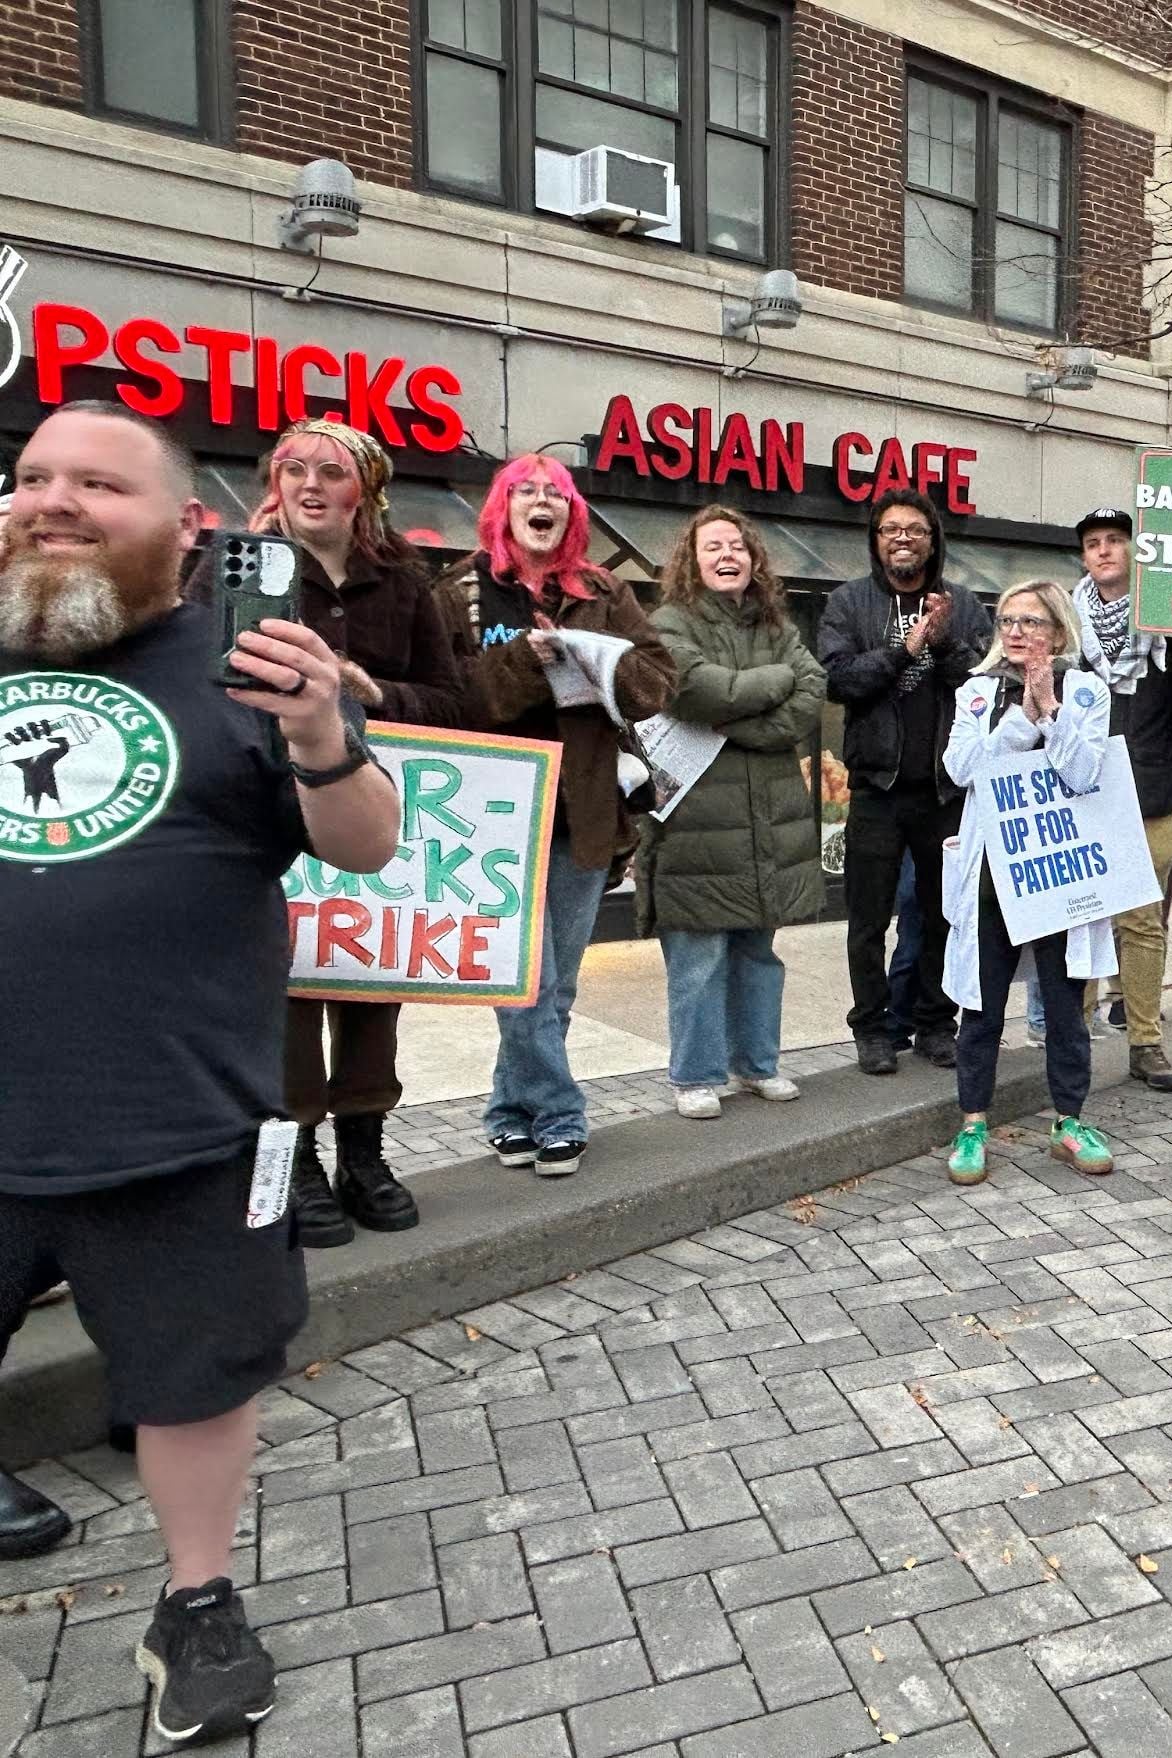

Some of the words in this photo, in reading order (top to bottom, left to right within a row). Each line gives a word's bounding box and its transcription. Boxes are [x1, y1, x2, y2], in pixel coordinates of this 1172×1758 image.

[33, 303, 464, 452] PSTICKS
[596, 394, 804, 493] ASIAN
[833, 431, 976, 515] CAFE
[73, 762, 161, 838] UNITED
[991, 774, 1028, 812] WE
[1001, 817, 1029, 855] UP
[1035, 807, 1079, 846] FOR
[1009, 843, 1108, 898] PATIENTS
